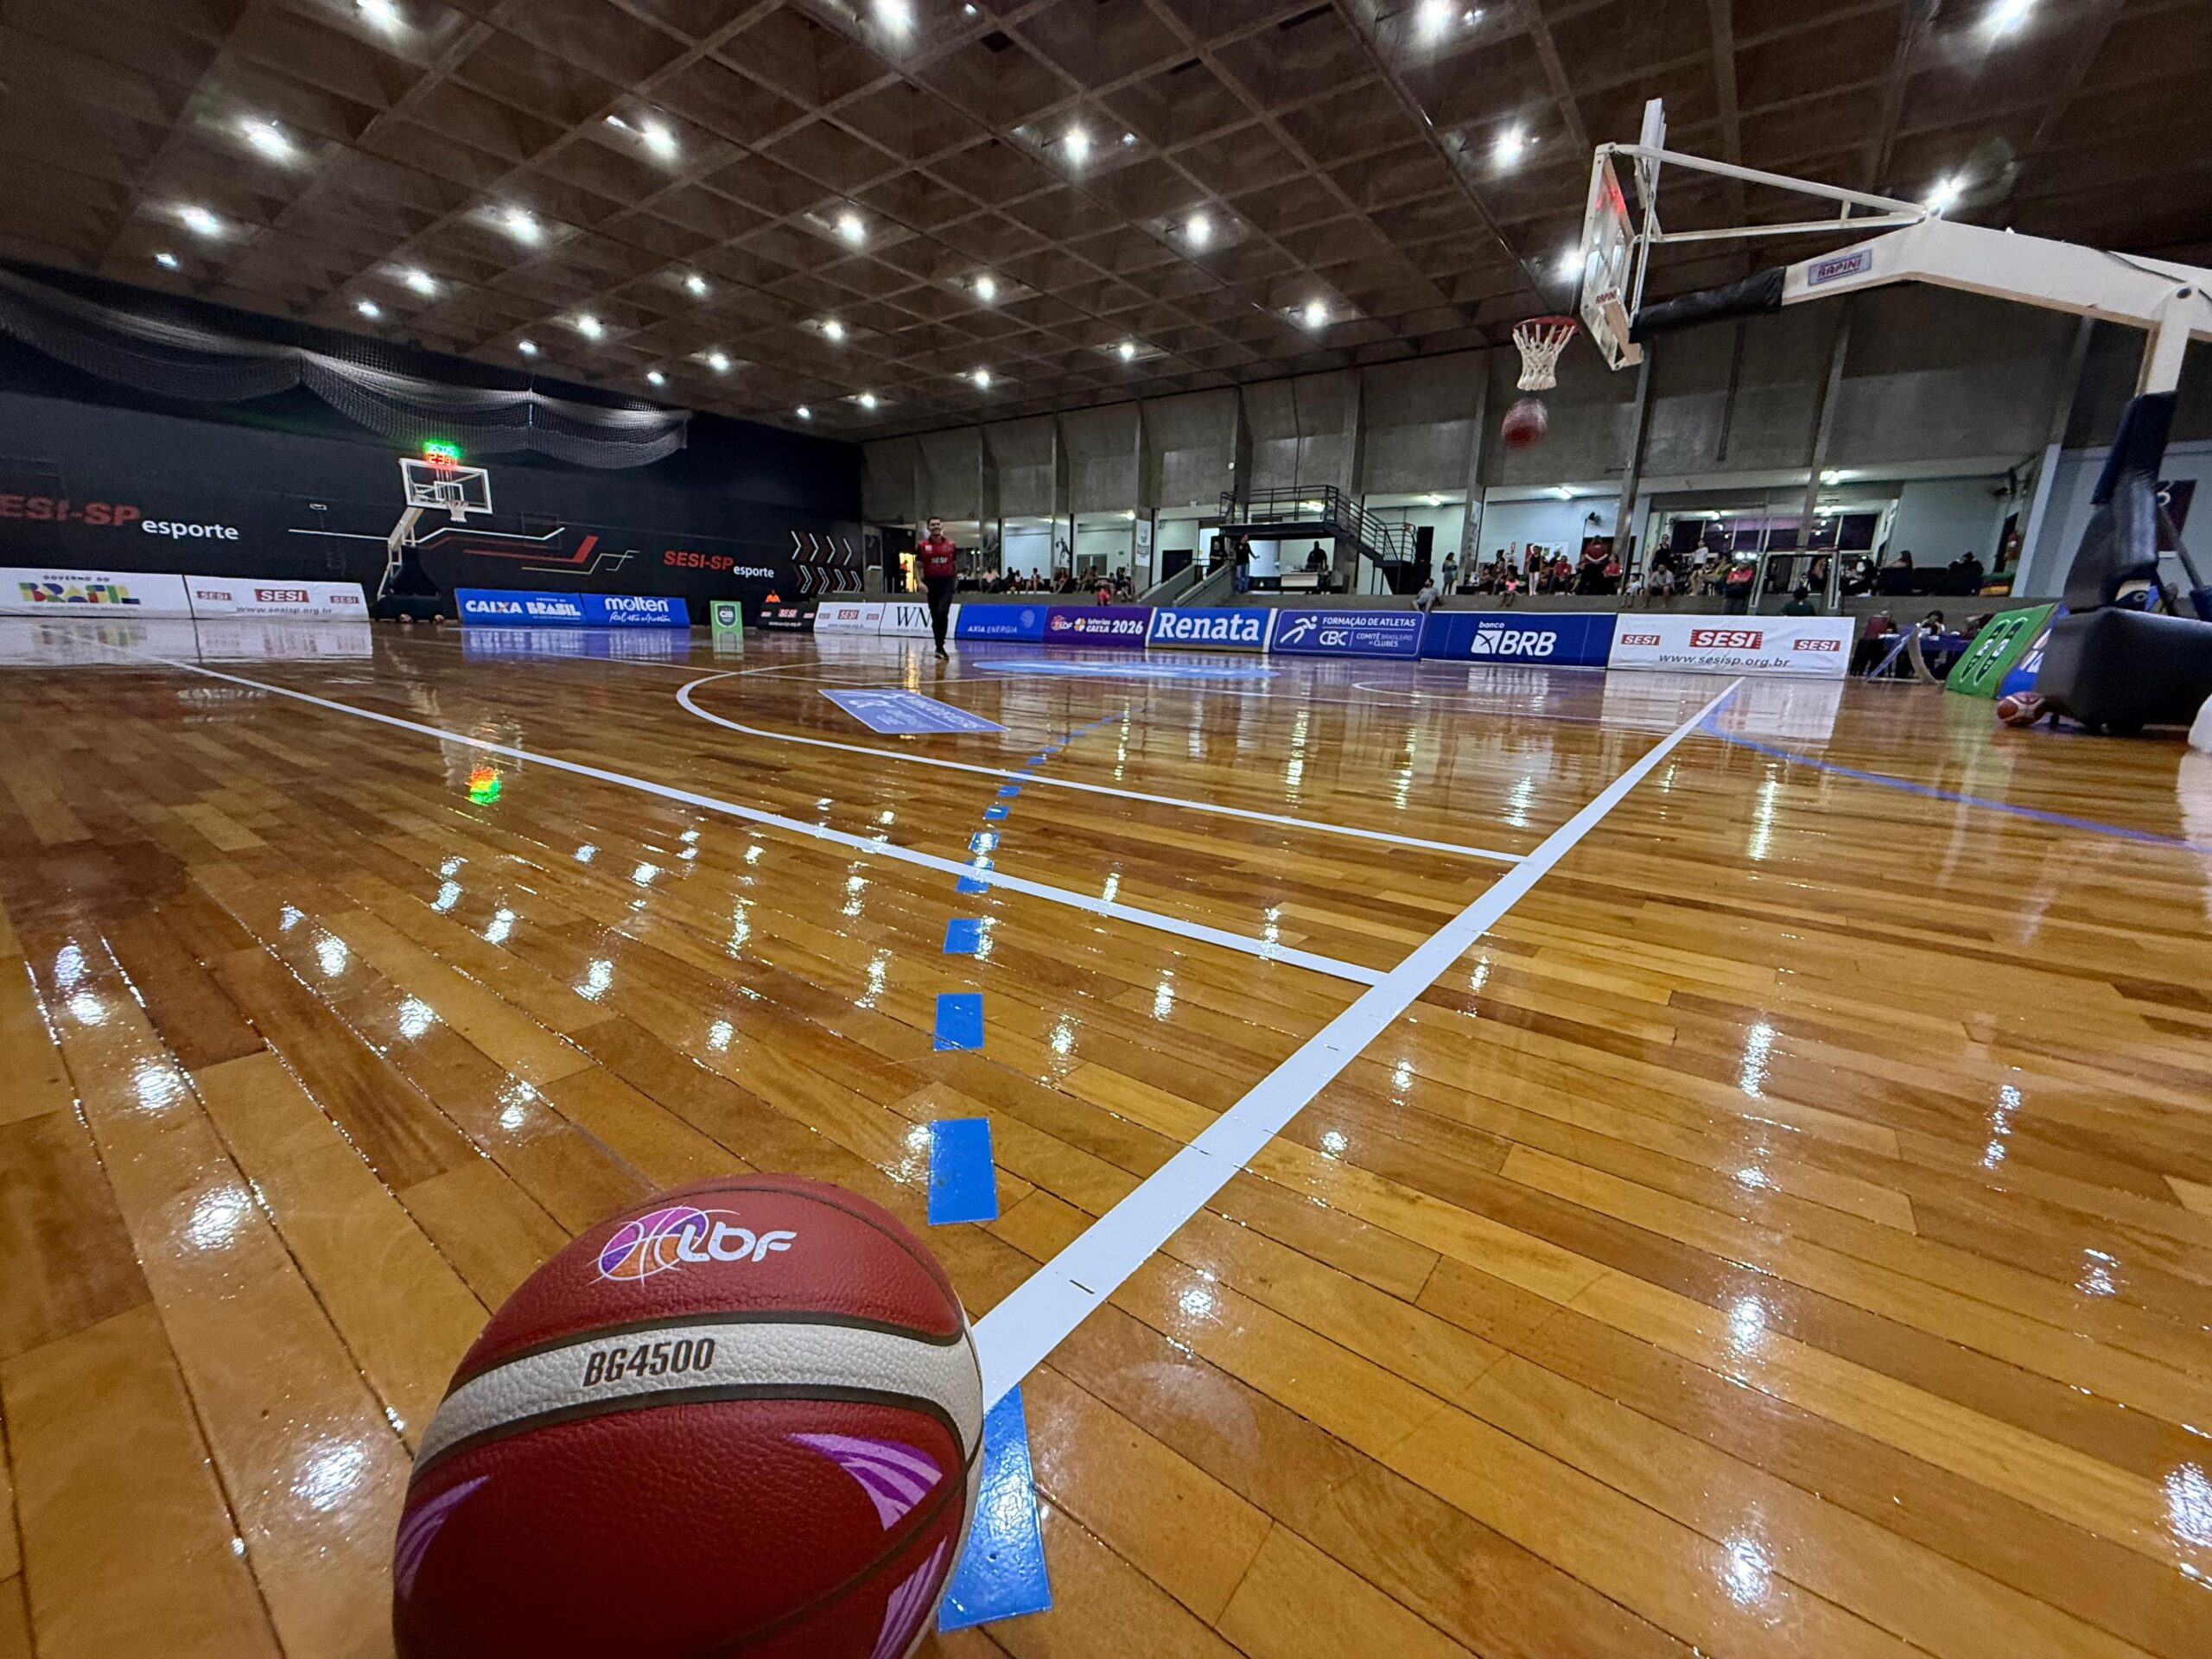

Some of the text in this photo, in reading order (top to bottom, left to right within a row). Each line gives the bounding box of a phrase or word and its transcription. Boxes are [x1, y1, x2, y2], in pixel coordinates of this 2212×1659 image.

[1818, 258, 1862, 279] RAPINI
[142, 519, 239, 540] esporte
[664, 550, 774, 578] SESI-SP esporte
[19, 582, 140, 604] BRASIL
[200, 592, 229, 601] SESI
[260, 591, 303, 602] SESI
[466, 600, 523, 614] CAIXA
[526, 601, 581, 616] BRASIL
[605, 596, 669, 612] molten
[779, 608, 798, 618] SESI
[839, 611, 858, 620] SESI
[1111, 620, 1143, 634] 2026
[1154, 612, 1260, 641] Renata
[1323, 617, 1365, 627] FORMAÇÃO
[1380, 618, 1415, 627] ATLETAS
[1319, 631, 1348, 646] CBC
[1356, 632, 1380, 640] COMITÊ
[1373, 639, 1398, 648] CLUBES
[1498, 630, 1557, 657] BRB
[1624, 631, 1838, 651] SESI SESI SESI
[1659, 653, 1791, 668] www.sesisp.org.br
[582, 1338, 716, 1387] BG4500
